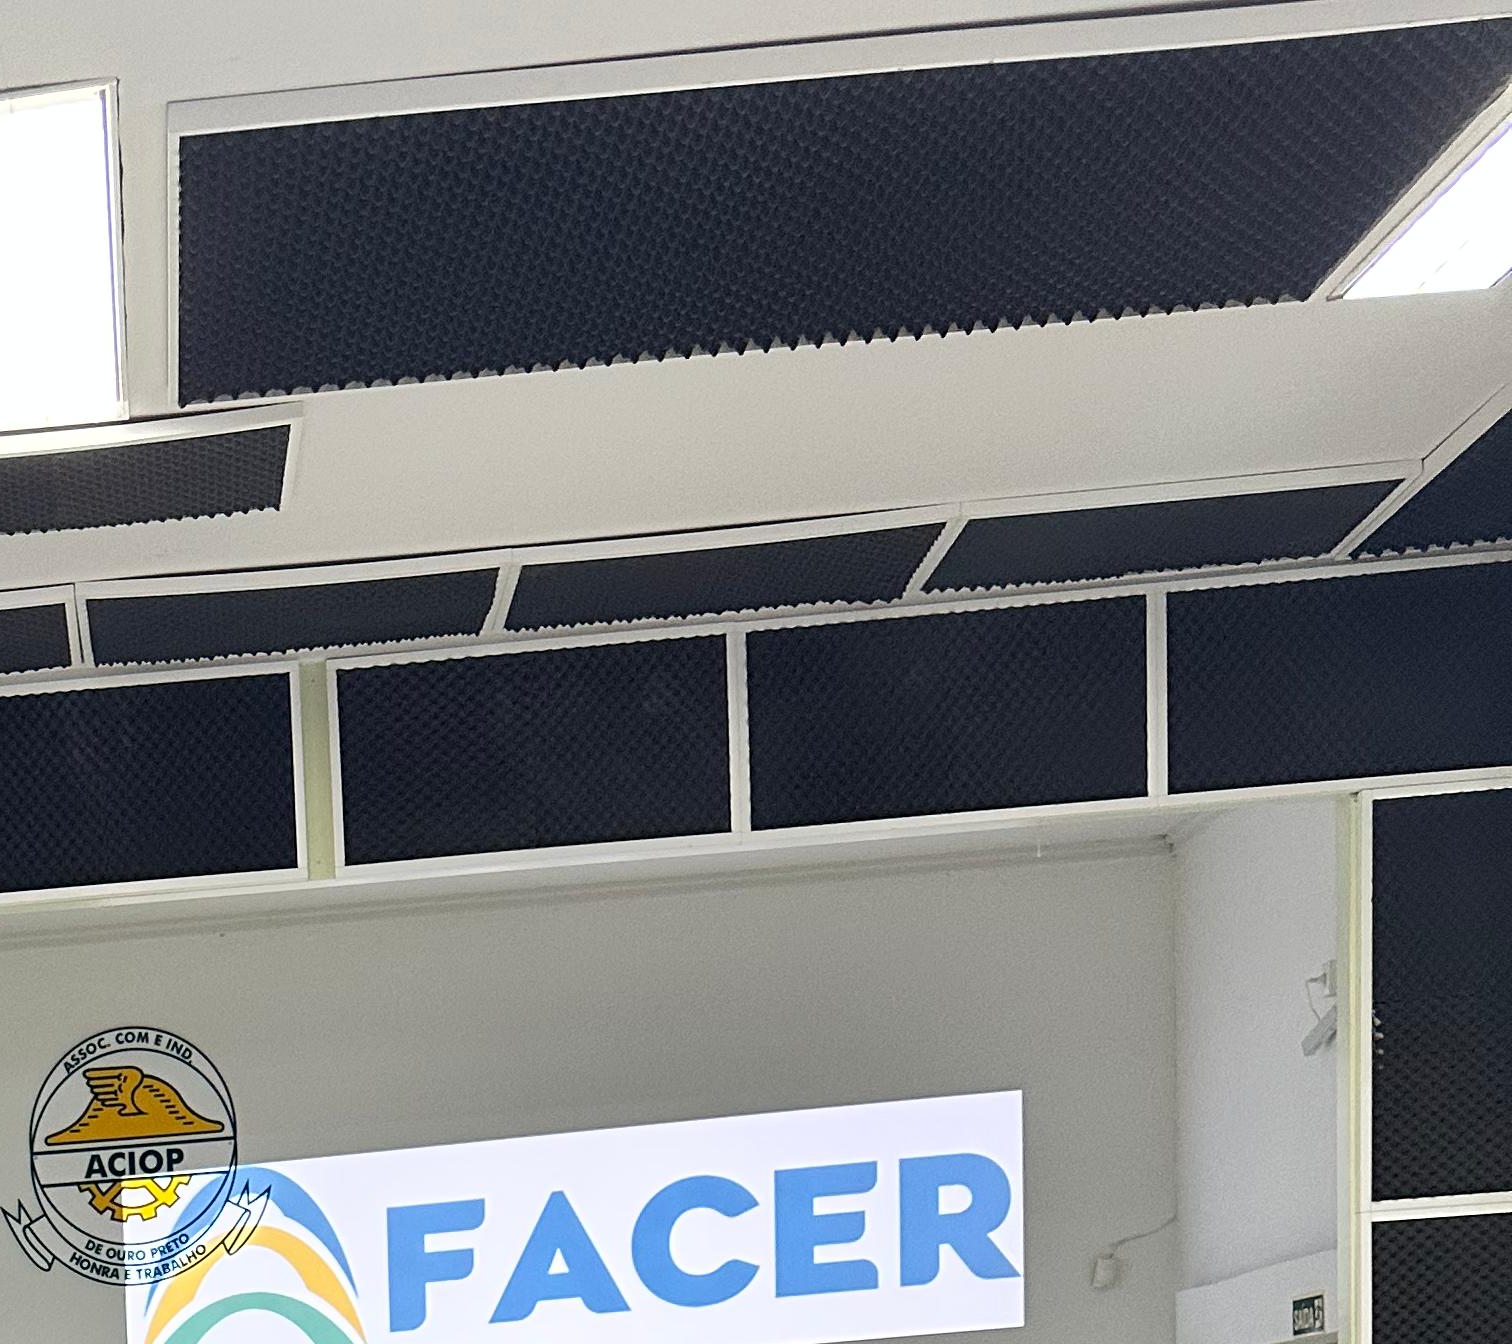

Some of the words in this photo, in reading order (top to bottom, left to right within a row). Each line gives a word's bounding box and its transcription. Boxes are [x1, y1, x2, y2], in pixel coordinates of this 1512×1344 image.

[63, 1037, 111, 1074] ASSOC.
[115, 1031, 149, 1044] COM
[154, 1034, 163, 1046] E
[166, 1038, 193, 1065] IND.
[85, 1148, 184, 1179] ACIOP
[85, 1240, 103, 1255] DE
[106, 1247, 145, 1261] OURO
[150, 1233, 189, 1258] PRETO
[386, 1152, 1021, 1333] FACER
[69, 1252, 119, 1280] HONRA
[124, 1269, 131, 1280] E
[136, 1244, 206, 1279] TRABALHO
